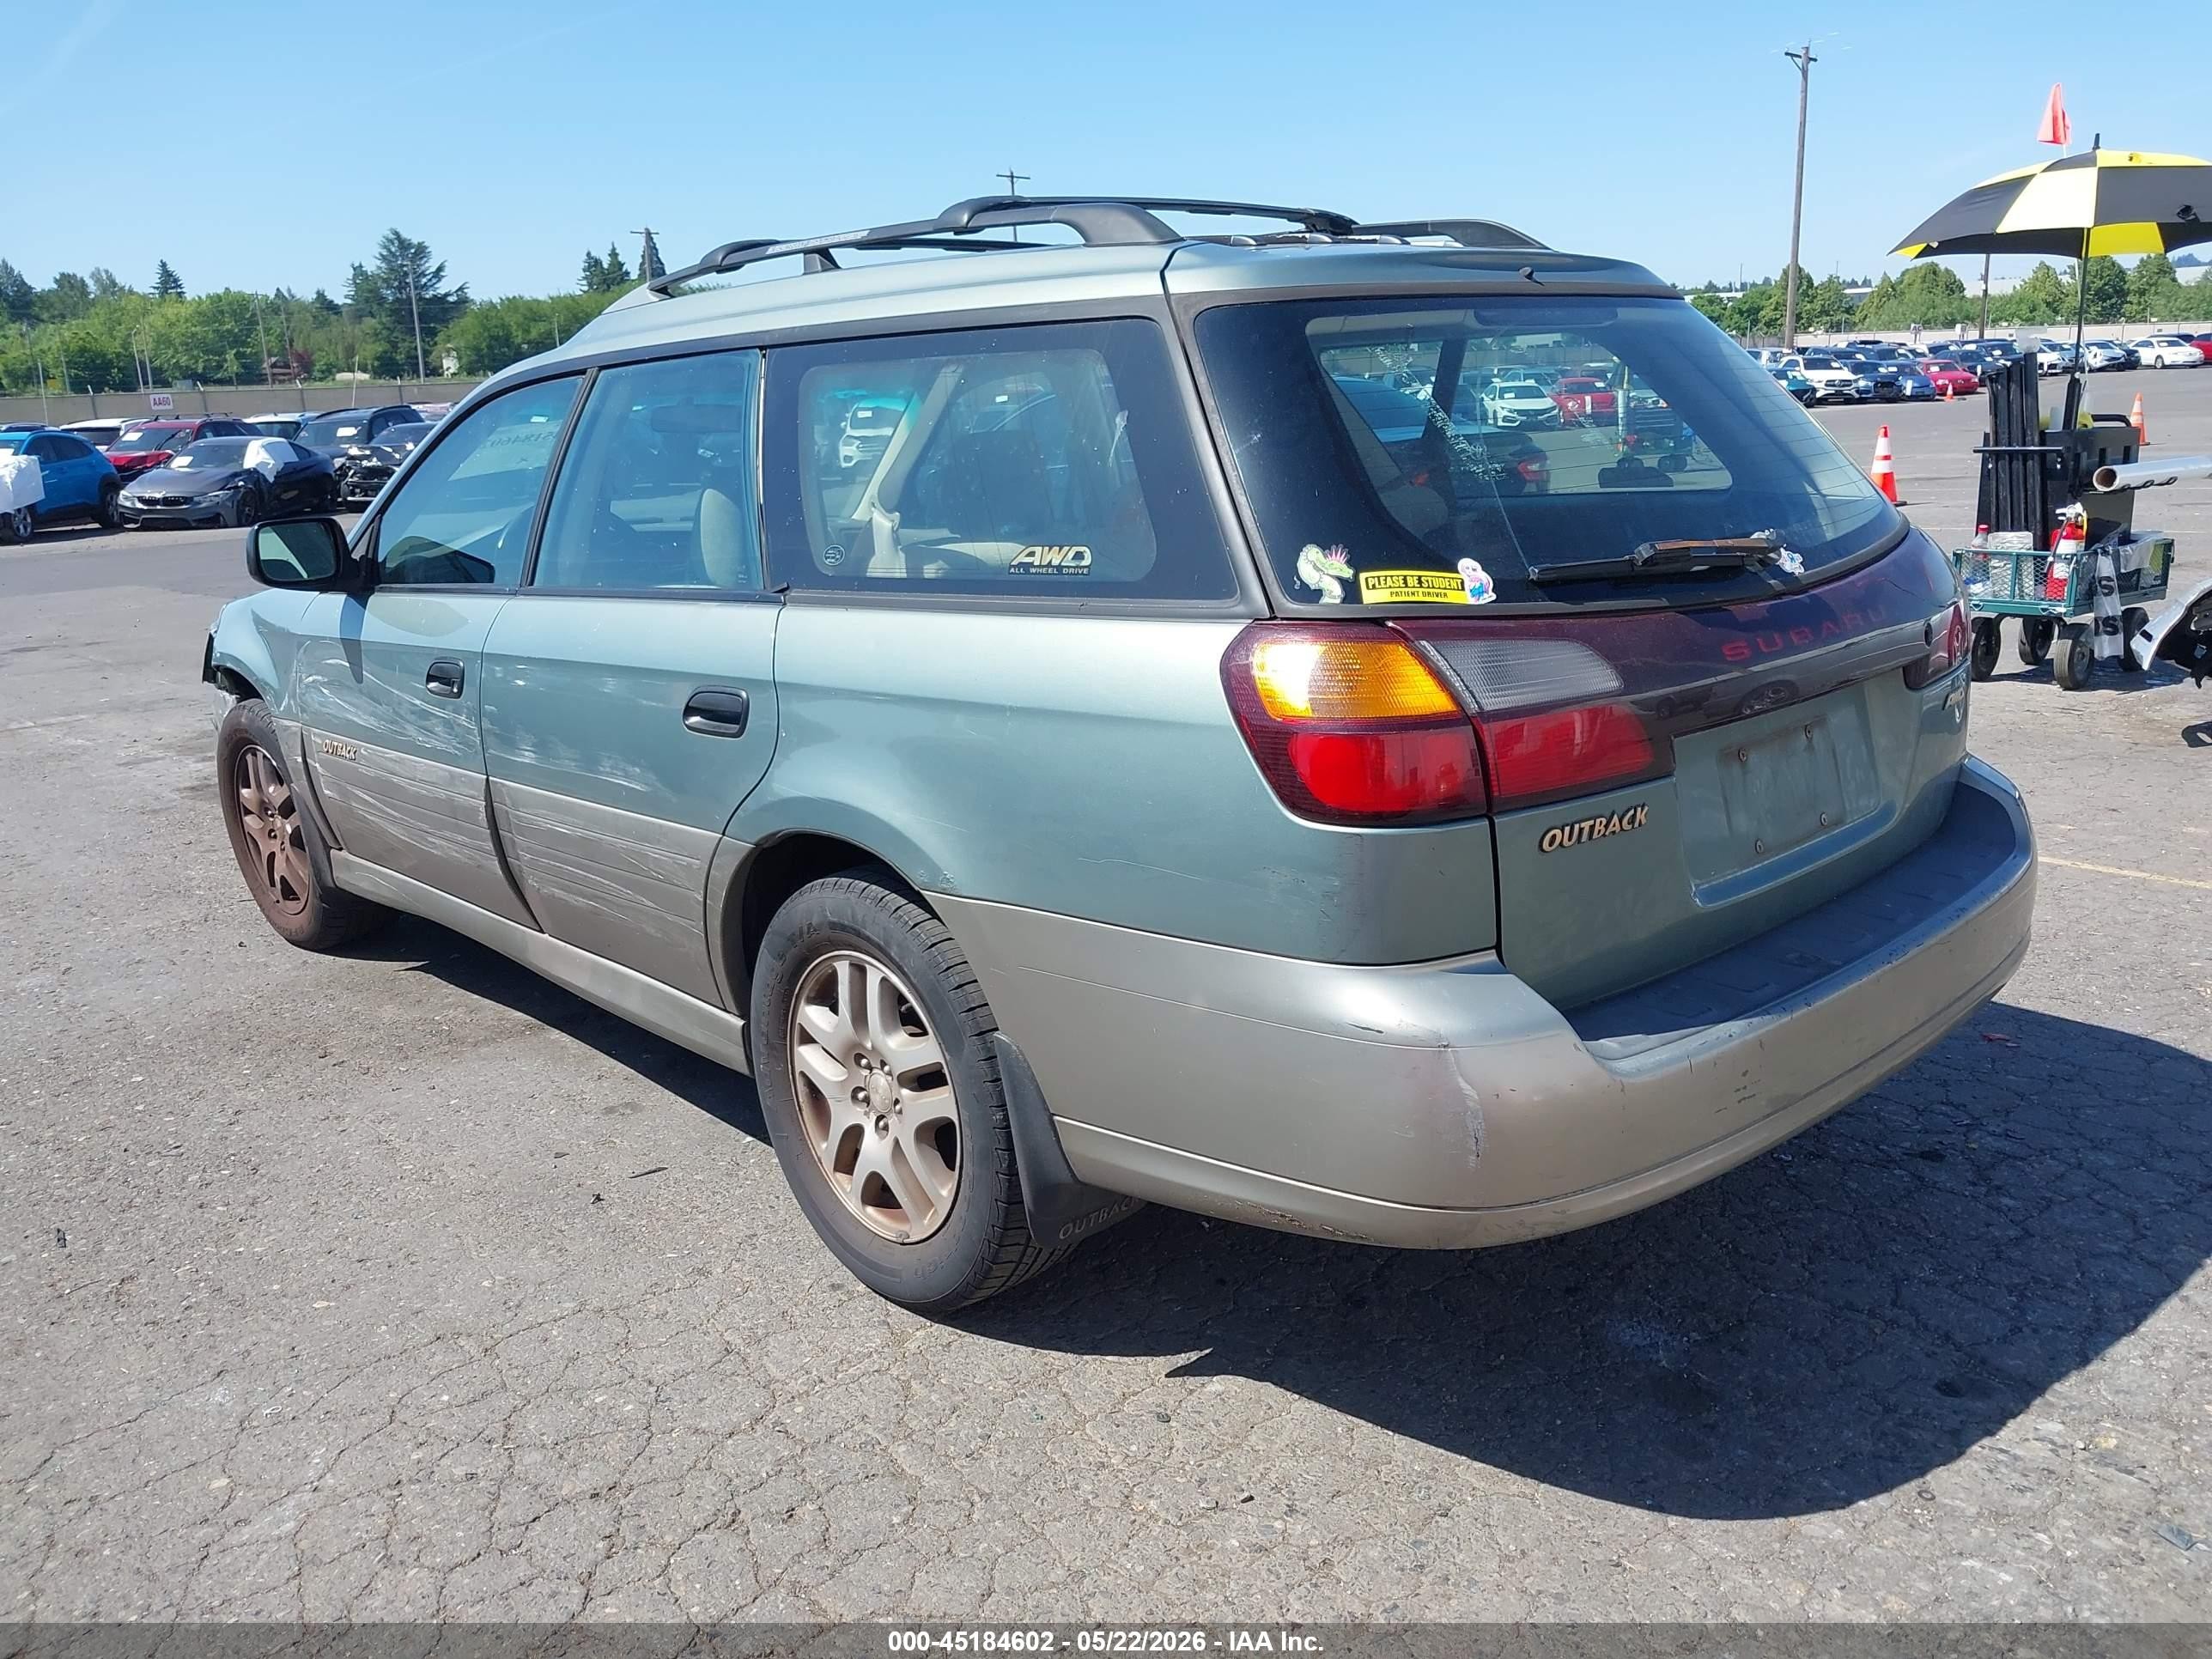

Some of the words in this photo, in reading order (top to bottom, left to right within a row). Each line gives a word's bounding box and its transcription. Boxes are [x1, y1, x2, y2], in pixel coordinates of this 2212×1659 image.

[1010, 545, 1092, 566] AWD
[1368, 575, 1405, 589] PLEASE
[1407, 576, 1419, 587] BE
[1421, 576, 1462, 590] STUDENT
[1721, 605, 1886, 661] SUBARU
[323, 739, 357, 761] OUTBACK
[1540, 805, 1649, 852] OUTBACK
